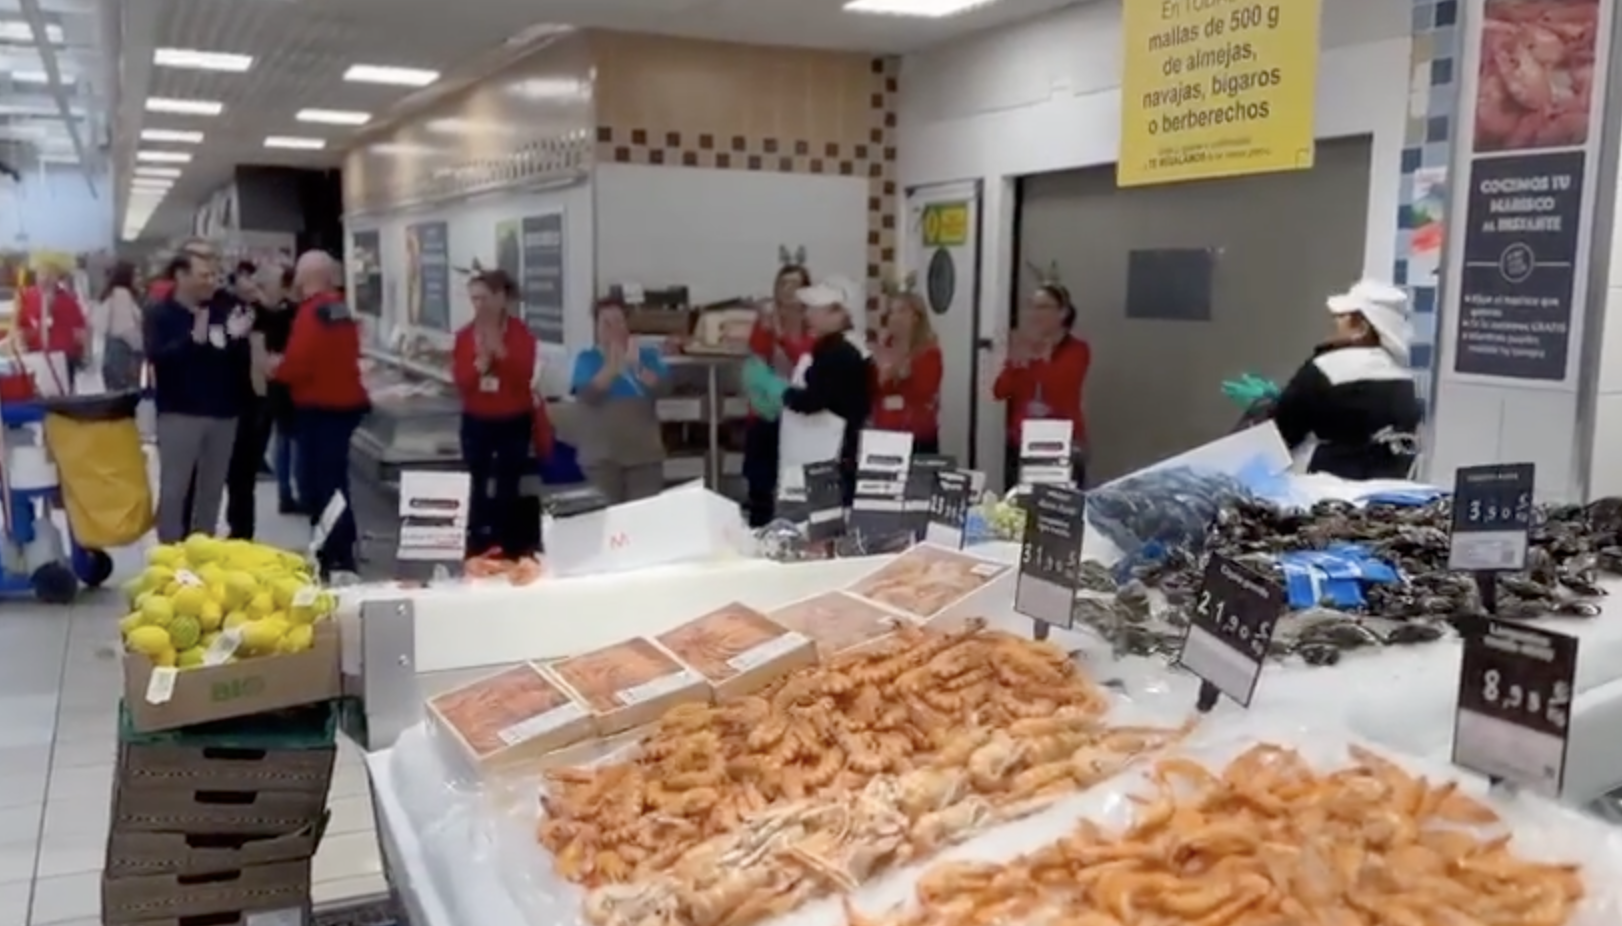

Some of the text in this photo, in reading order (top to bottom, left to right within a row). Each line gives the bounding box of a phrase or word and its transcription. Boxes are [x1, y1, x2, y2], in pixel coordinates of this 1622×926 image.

[1161, 0, 1180, 19] En
[1149, 5, 1280, 51] mallas de 500 g
[1163, 42, 1257, 76] de almejas,
[1142, 82, 1206, 109] navajas,
[1148, 100, 1270, 135] o berberechos
[1551, 174, 1571, 191] TU
